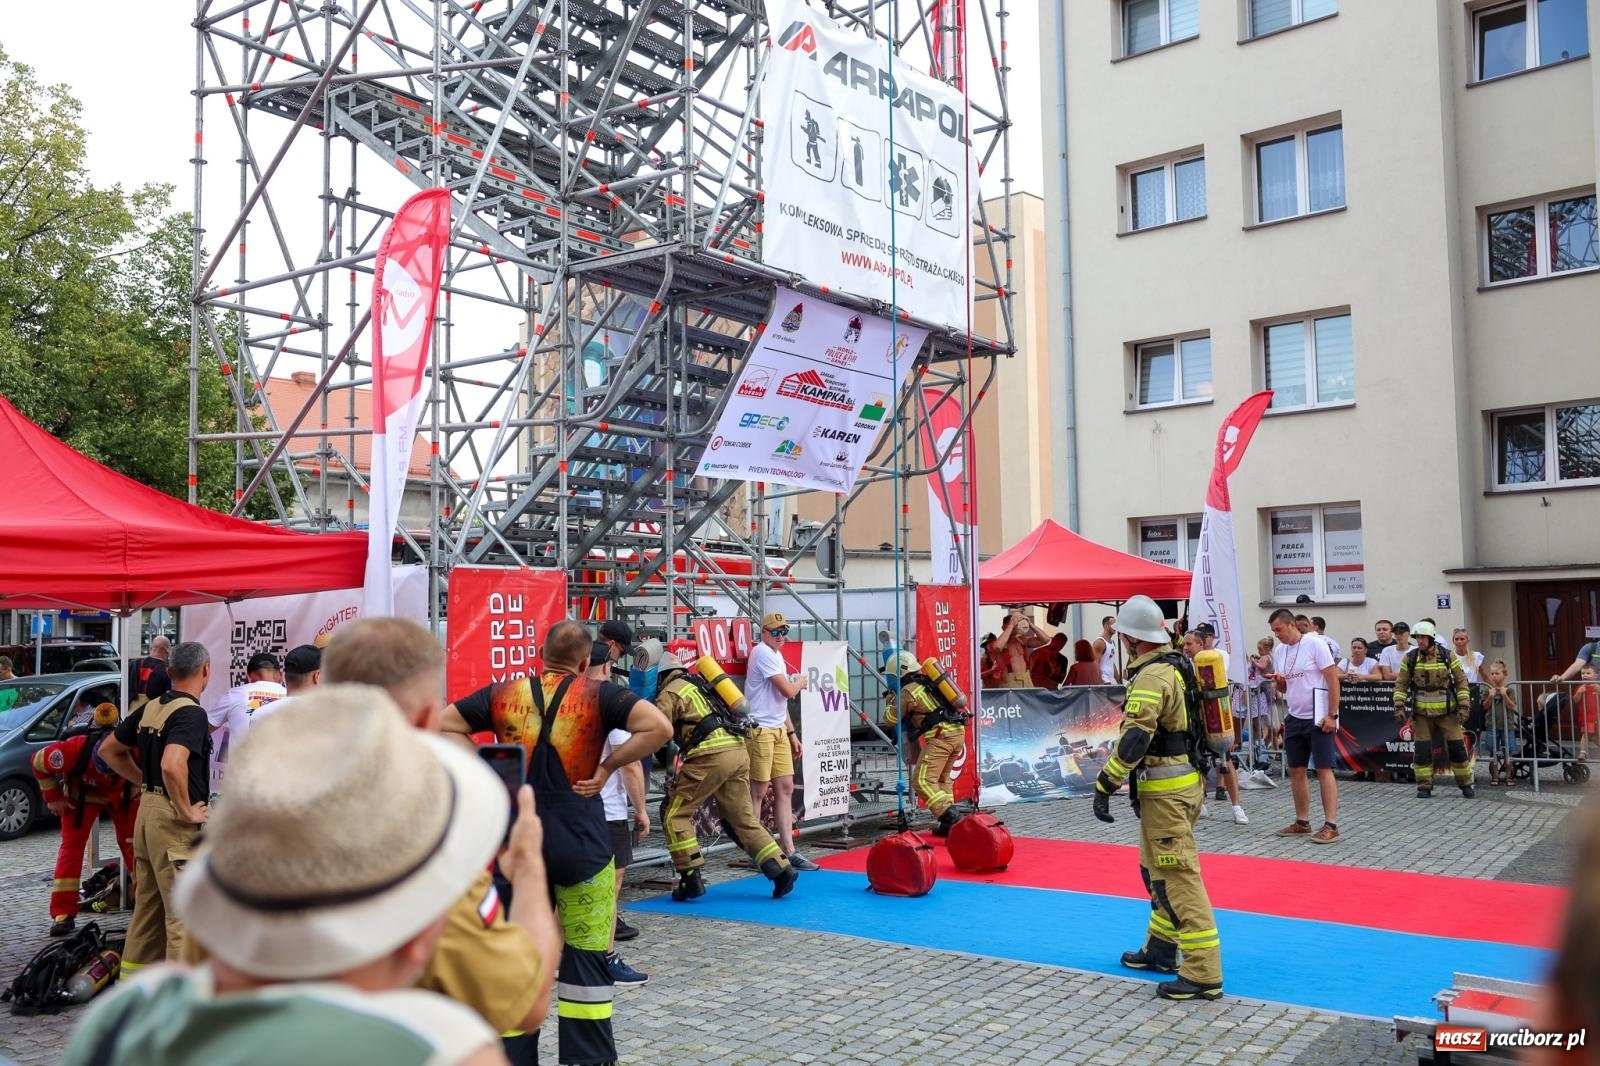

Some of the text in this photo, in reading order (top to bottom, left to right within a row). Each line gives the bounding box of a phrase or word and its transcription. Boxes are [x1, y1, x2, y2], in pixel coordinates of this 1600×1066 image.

[823, 51, 972, 147] ARPAPOL
[779, 202, 844, 239] KOMLEKSOWA
[800, 384, 846, 404] KAMPKA
[820, 428, 862, 444] KAREN
[769, 467, 806, 479] TECHNOLOGY
[807, 666, 834, 693] Re
[817, 751, 831, 759] ORAZ
[820, 758, 848, 773] RE-WI
[818, 785, 845, 797] Sudecka
[829, 796, 841, 805] 755
[1160, 856, 1175, 865] PSP
